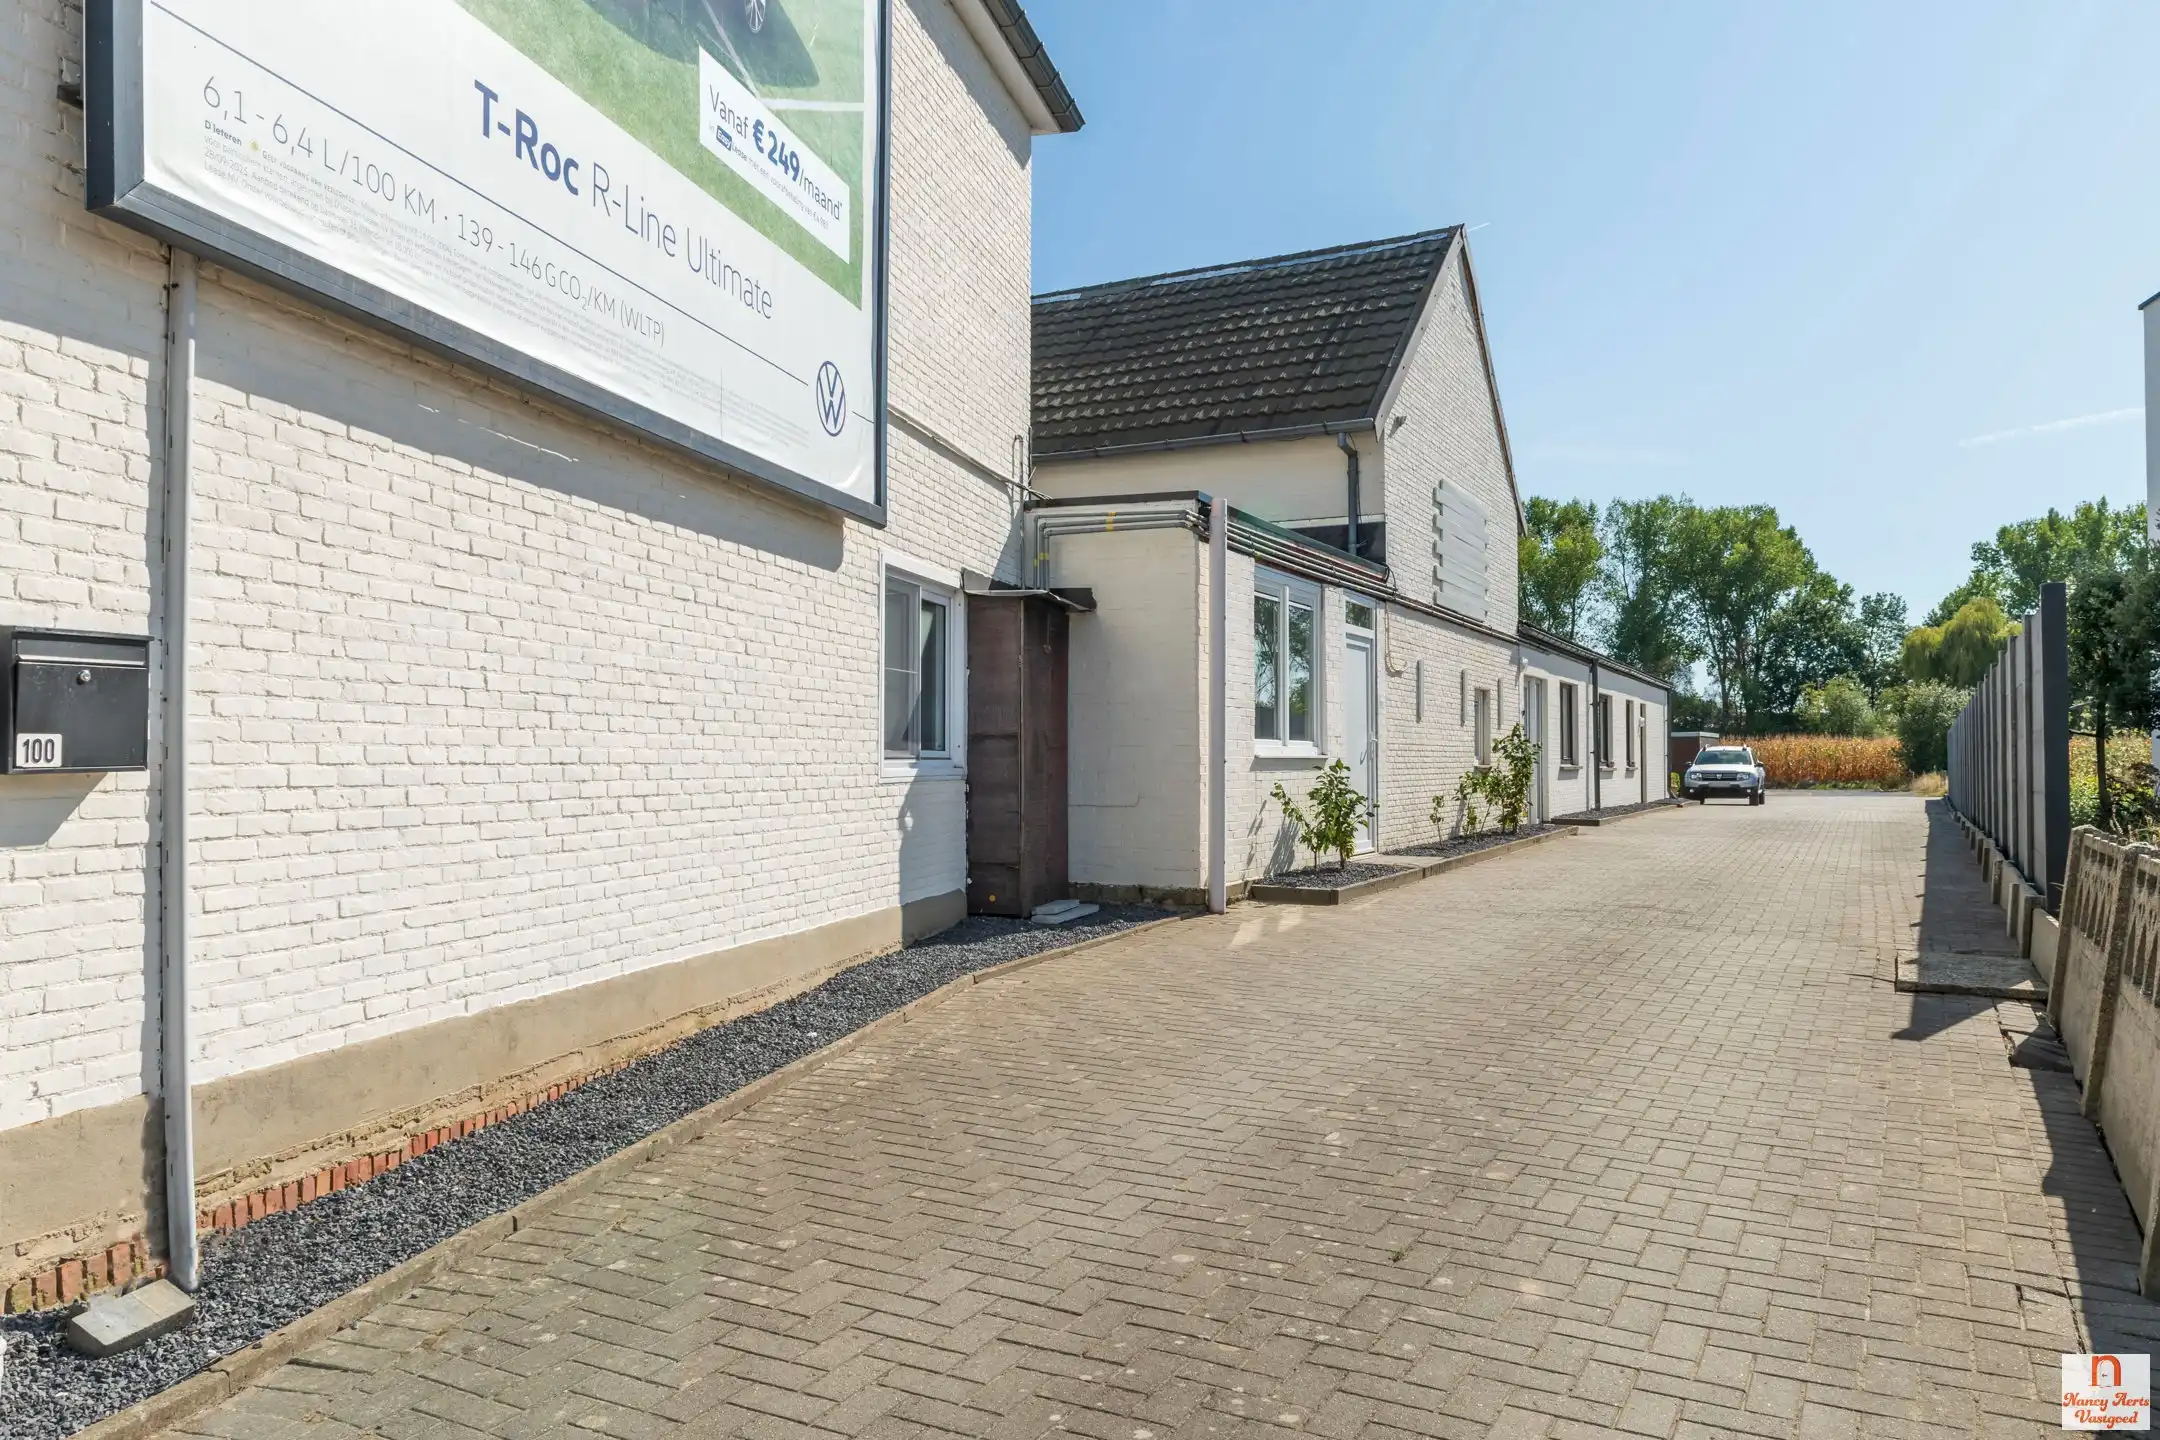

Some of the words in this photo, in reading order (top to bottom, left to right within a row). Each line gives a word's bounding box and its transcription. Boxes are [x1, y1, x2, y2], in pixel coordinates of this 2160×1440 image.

[709, 84, 749, 139] Vanaf
[474, 79, 579, 196] T-Roc
[592, 161, 676, 258] R-Line
[686, 227, 773, 320] Ultimate
[404, 183, 435, 224] KM
[620, 290, 665, 347] (WLTP)
[22, 738, 55, 764] 100
